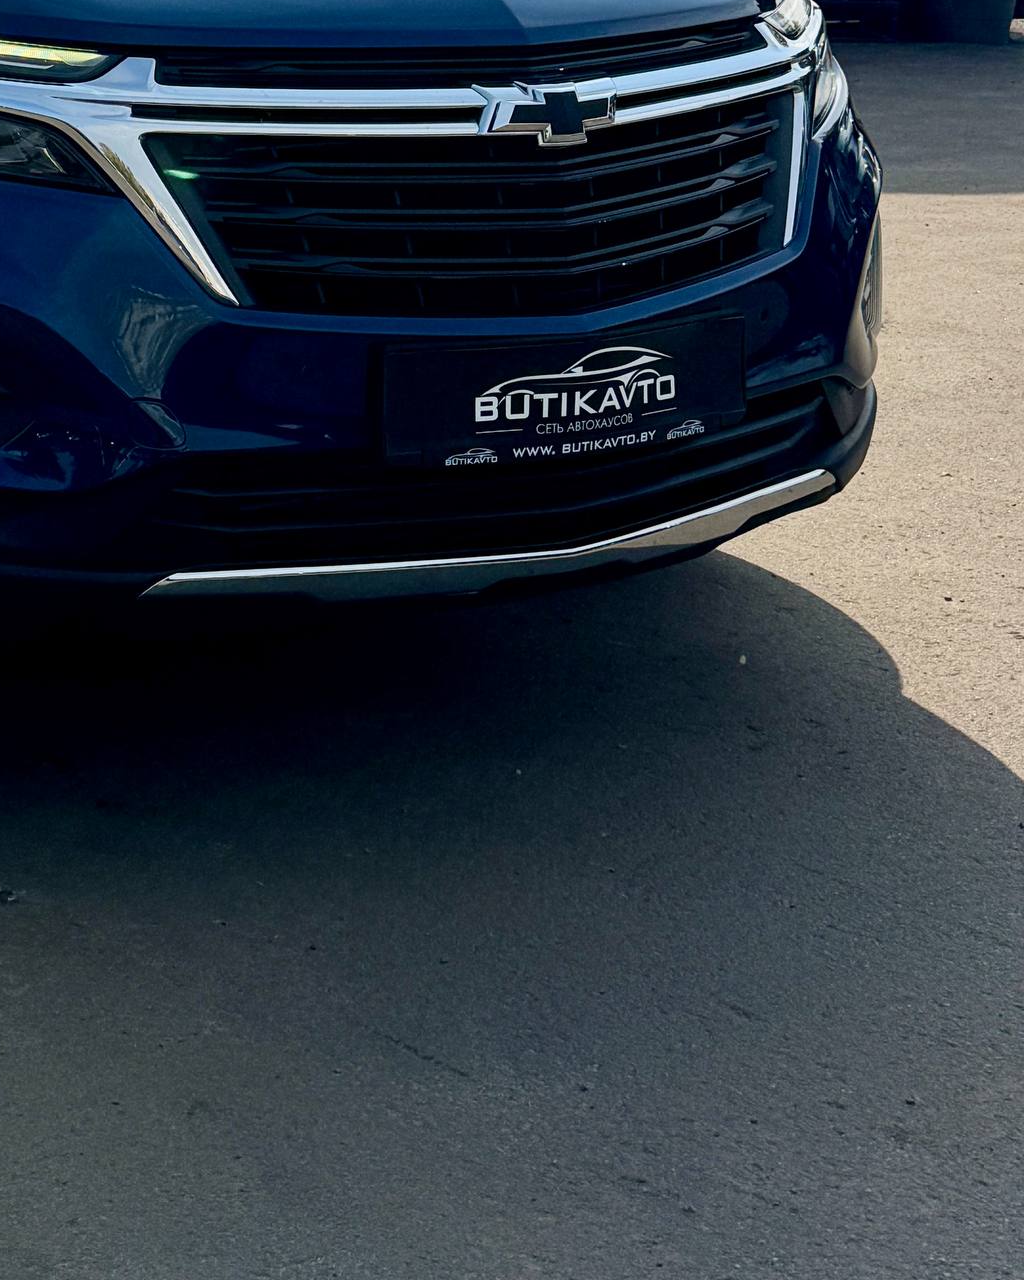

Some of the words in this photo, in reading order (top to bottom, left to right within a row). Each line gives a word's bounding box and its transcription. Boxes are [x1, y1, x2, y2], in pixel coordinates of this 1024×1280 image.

[475, 375, 676, 422] BUTIKAVTO
[536, 422, 564, 435] СЕТЬ
[567, 413, 633, 433] АВТОХАУСОВ
[667, 425, 705, 440] BUTIKAVTO
[513, 445, 555, 459] WWW.
[562, 430, 657, 454] BUTIKAVTO.BY
[445, 455, 498, 466] BUTIKAVTO
